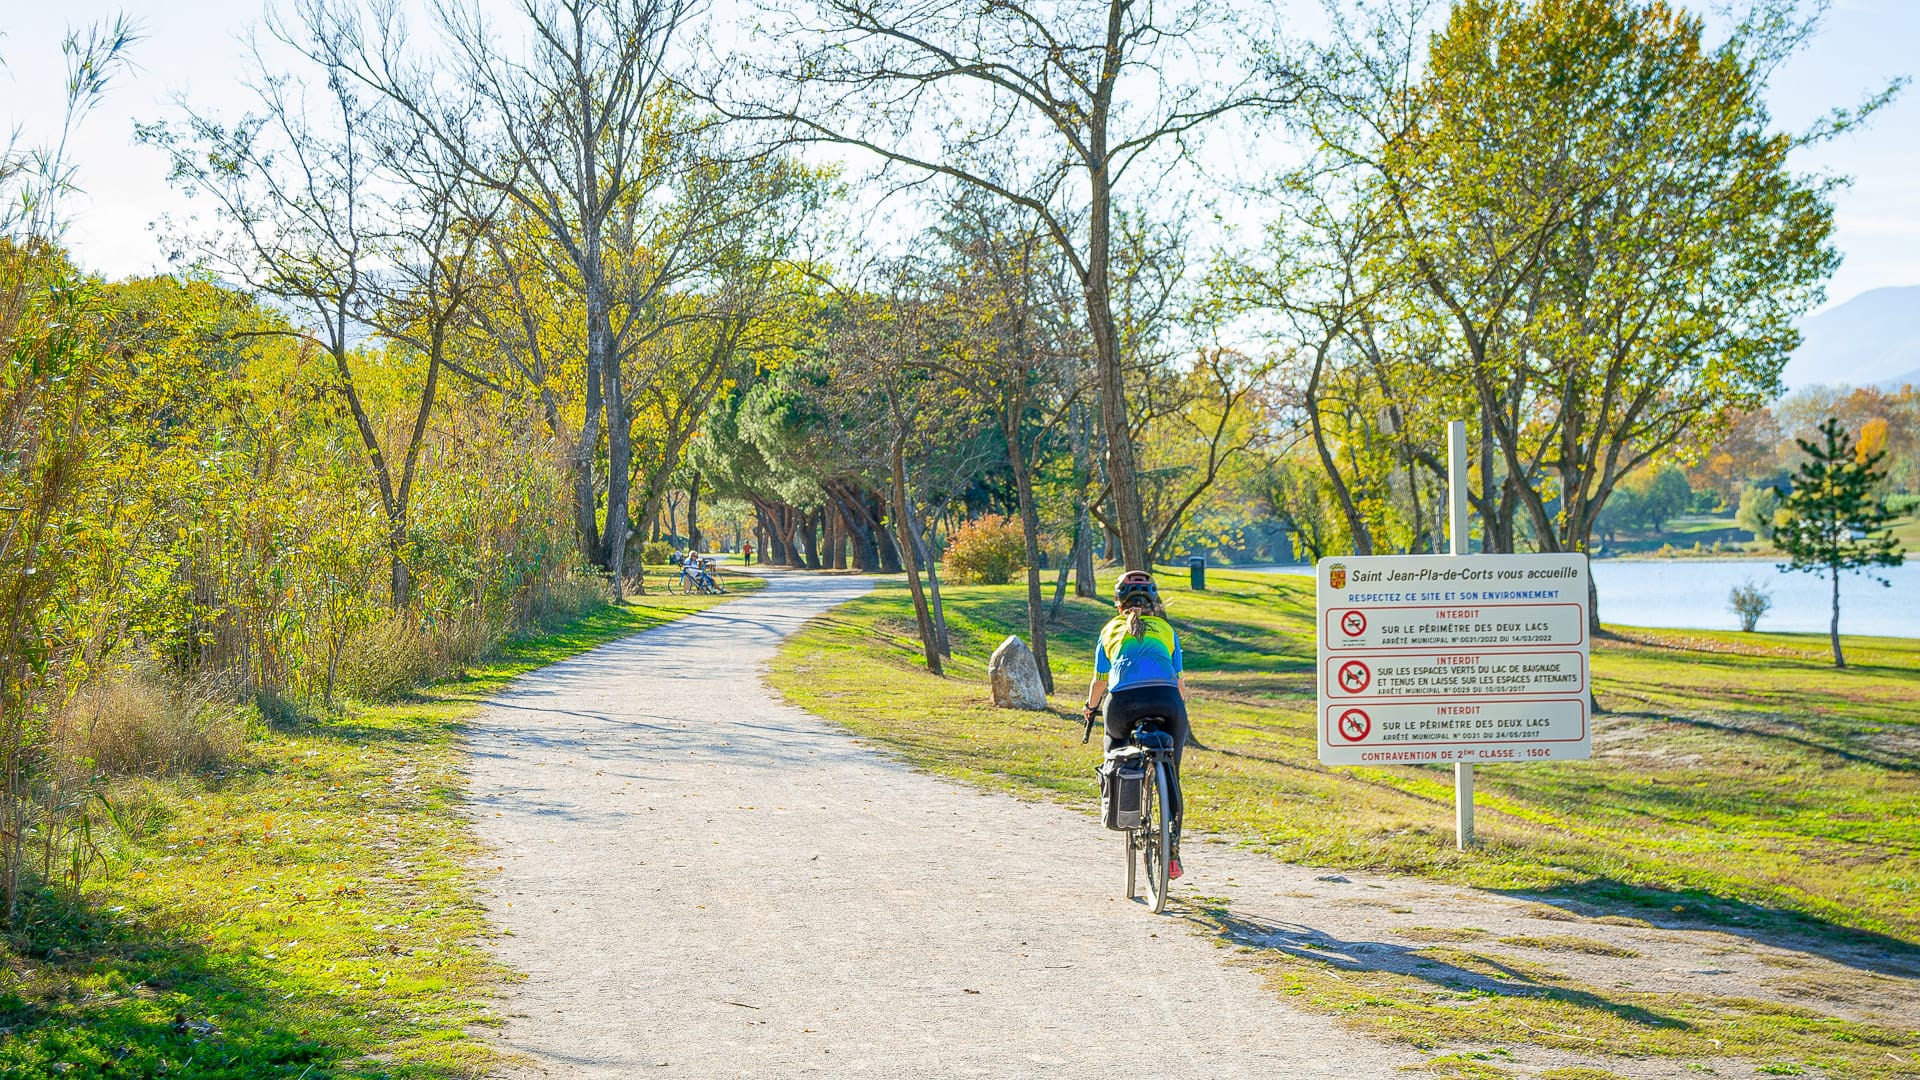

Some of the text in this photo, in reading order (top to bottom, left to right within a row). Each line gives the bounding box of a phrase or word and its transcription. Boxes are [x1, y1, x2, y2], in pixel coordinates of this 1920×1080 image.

[1352, 567, 1578, 582] Saint Jean-Pla-de-Corts vous accueille
[1349, 593, 1400, 602] RESPECTEZ
[1405, 592, 1416, 601] CE
[1421, 592, 1440, 600] SITE
[1445, 592, 1455, 600] ET
[1482, 590, 1559, 600] ENVIRONNEMENT
[1436, 610, 1479, 618] INTERDIT
[1382, 625, 1400, 634] SUR
[1404, 625, 1414, 633] LE
[1526, 623, 1549, 631] LACS
[1437, 657, 1480, 665] INTERDIT
[1414, 667, 1447, 675] ESPACES
[1523, 664, 1561, 672] BAIGNADE
[1534, 674, 1577, 683] ATTENANTS
[1437, 706, 1480, 715] INTERDIT
[1382, 722, 1400, 730] SUR
[1405, 722, 1416, 730] LE
[1526, 719, 1550, 727] LACS
[1362, 751, 1437, 760] CONTRAVENTION
[1479, 749, 1514, 758] CLASSE
[1527, 749, 1550, 757] 150€
